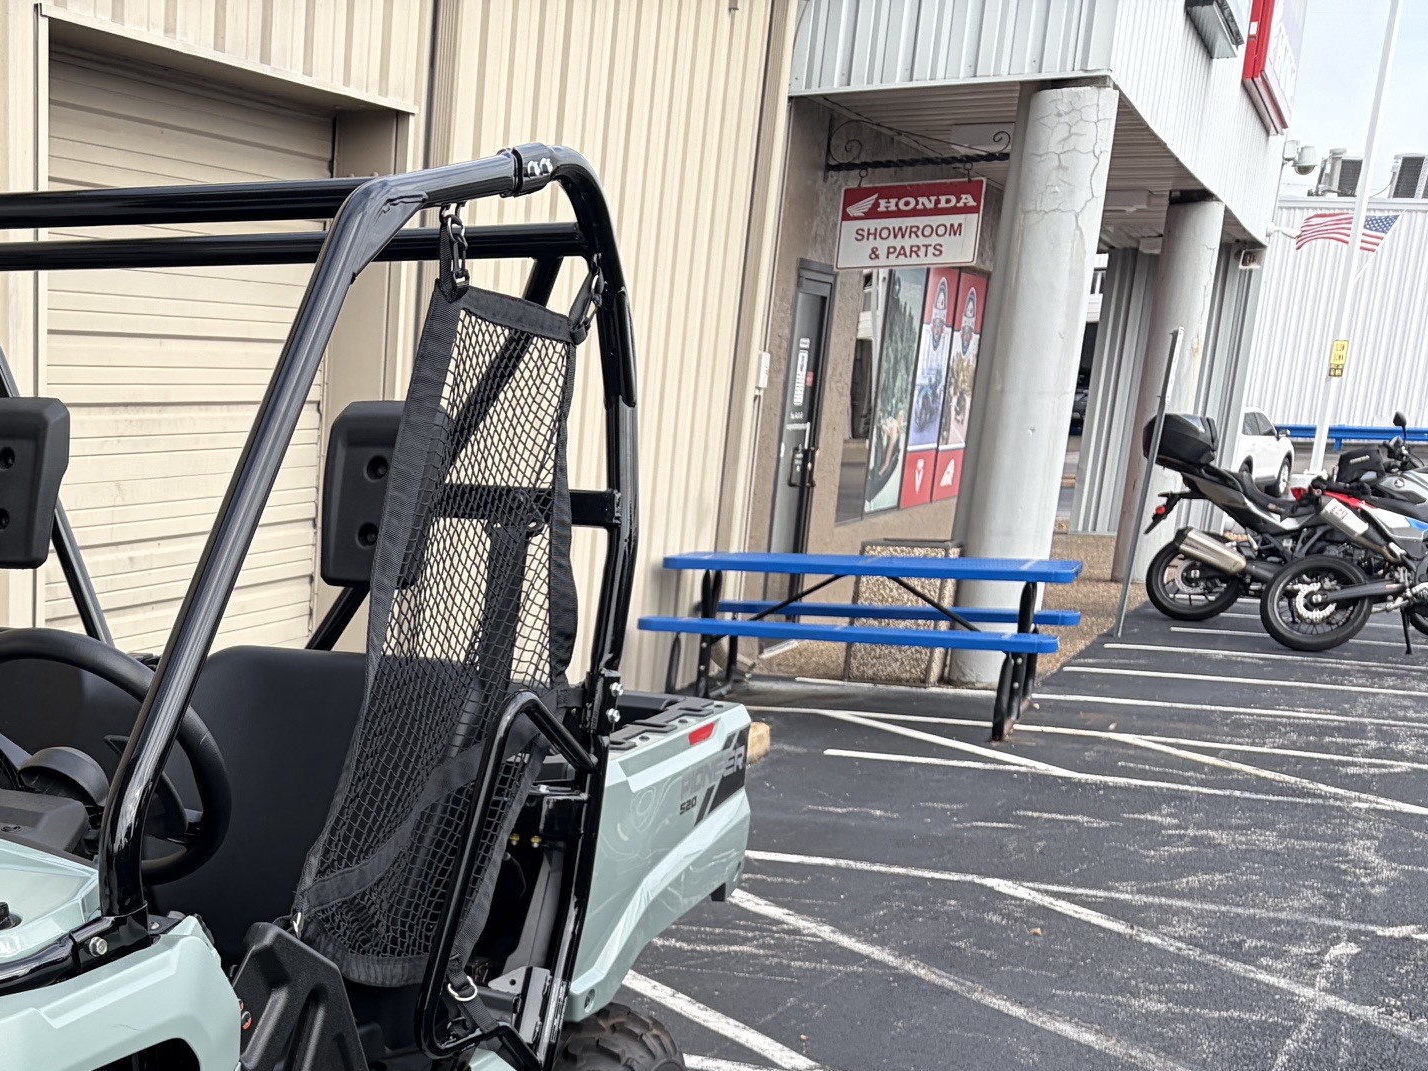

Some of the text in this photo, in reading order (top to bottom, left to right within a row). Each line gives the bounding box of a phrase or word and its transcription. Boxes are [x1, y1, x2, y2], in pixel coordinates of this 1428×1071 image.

[877, 193, 977, 213] HONDA
[854, 222, 963, 242] SHOWROOM
[868, 243, 943, 261] & PARTS
[680, 745, 746, 801] PIONEER
[679, 796, 698, 816] 520
